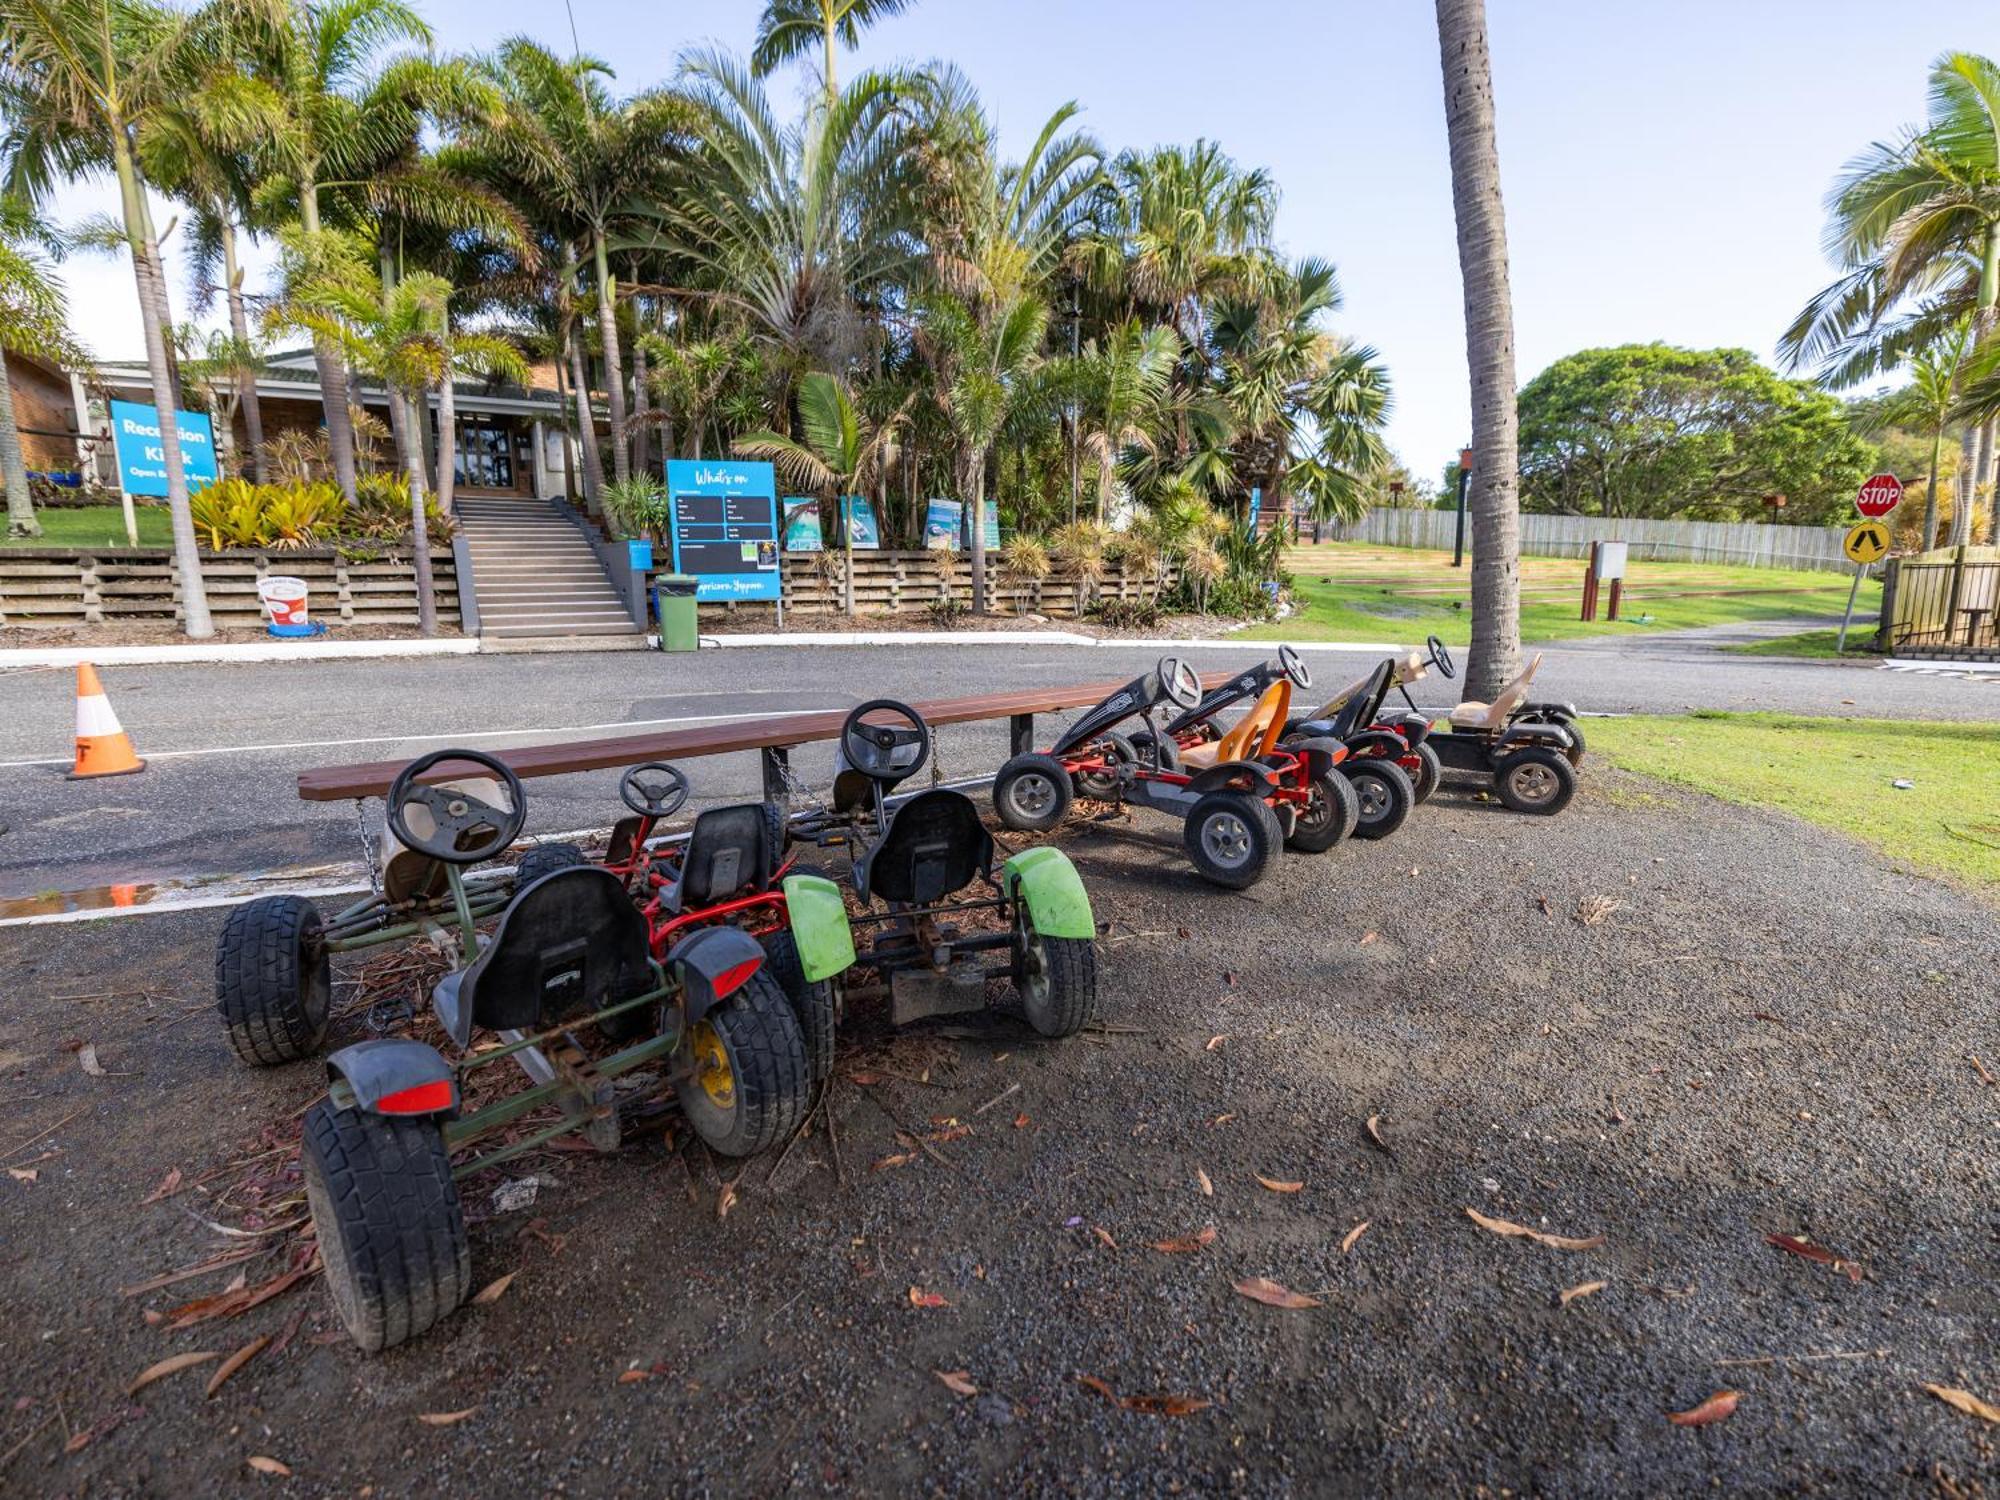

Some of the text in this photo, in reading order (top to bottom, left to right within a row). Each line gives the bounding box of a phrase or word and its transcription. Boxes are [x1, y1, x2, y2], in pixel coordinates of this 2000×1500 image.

[123, 418, 206, 444] Recetion
[144, 446, 193, 466] Kik
[695, 468, 733, 486] What's
[1859, 487, 1899, 505] STOP
